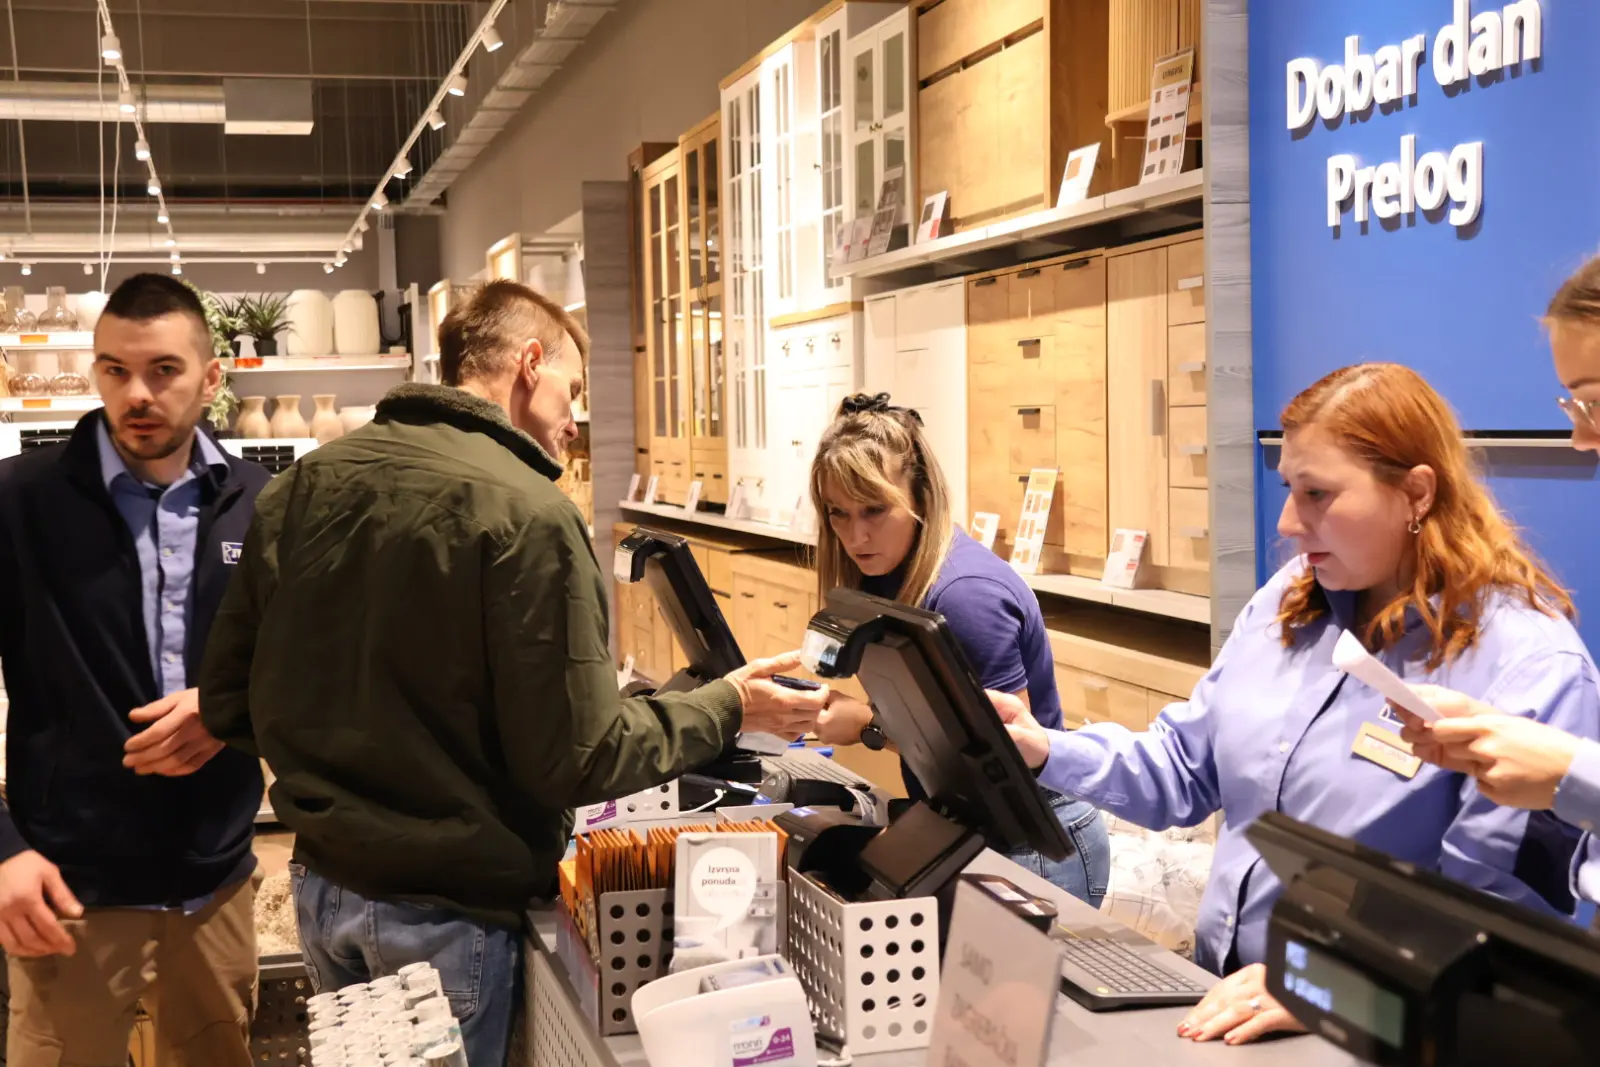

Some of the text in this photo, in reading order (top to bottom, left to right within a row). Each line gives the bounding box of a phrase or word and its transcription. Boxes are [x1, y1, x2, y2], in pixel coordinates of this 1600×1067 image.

[1286, 0, 1541, 129] Dobar dan
[1327, 134, 1482, 226] Prelog
[701, 877, 736, 887] ponuda
[708, 865, 740, 873] Izvrsna
